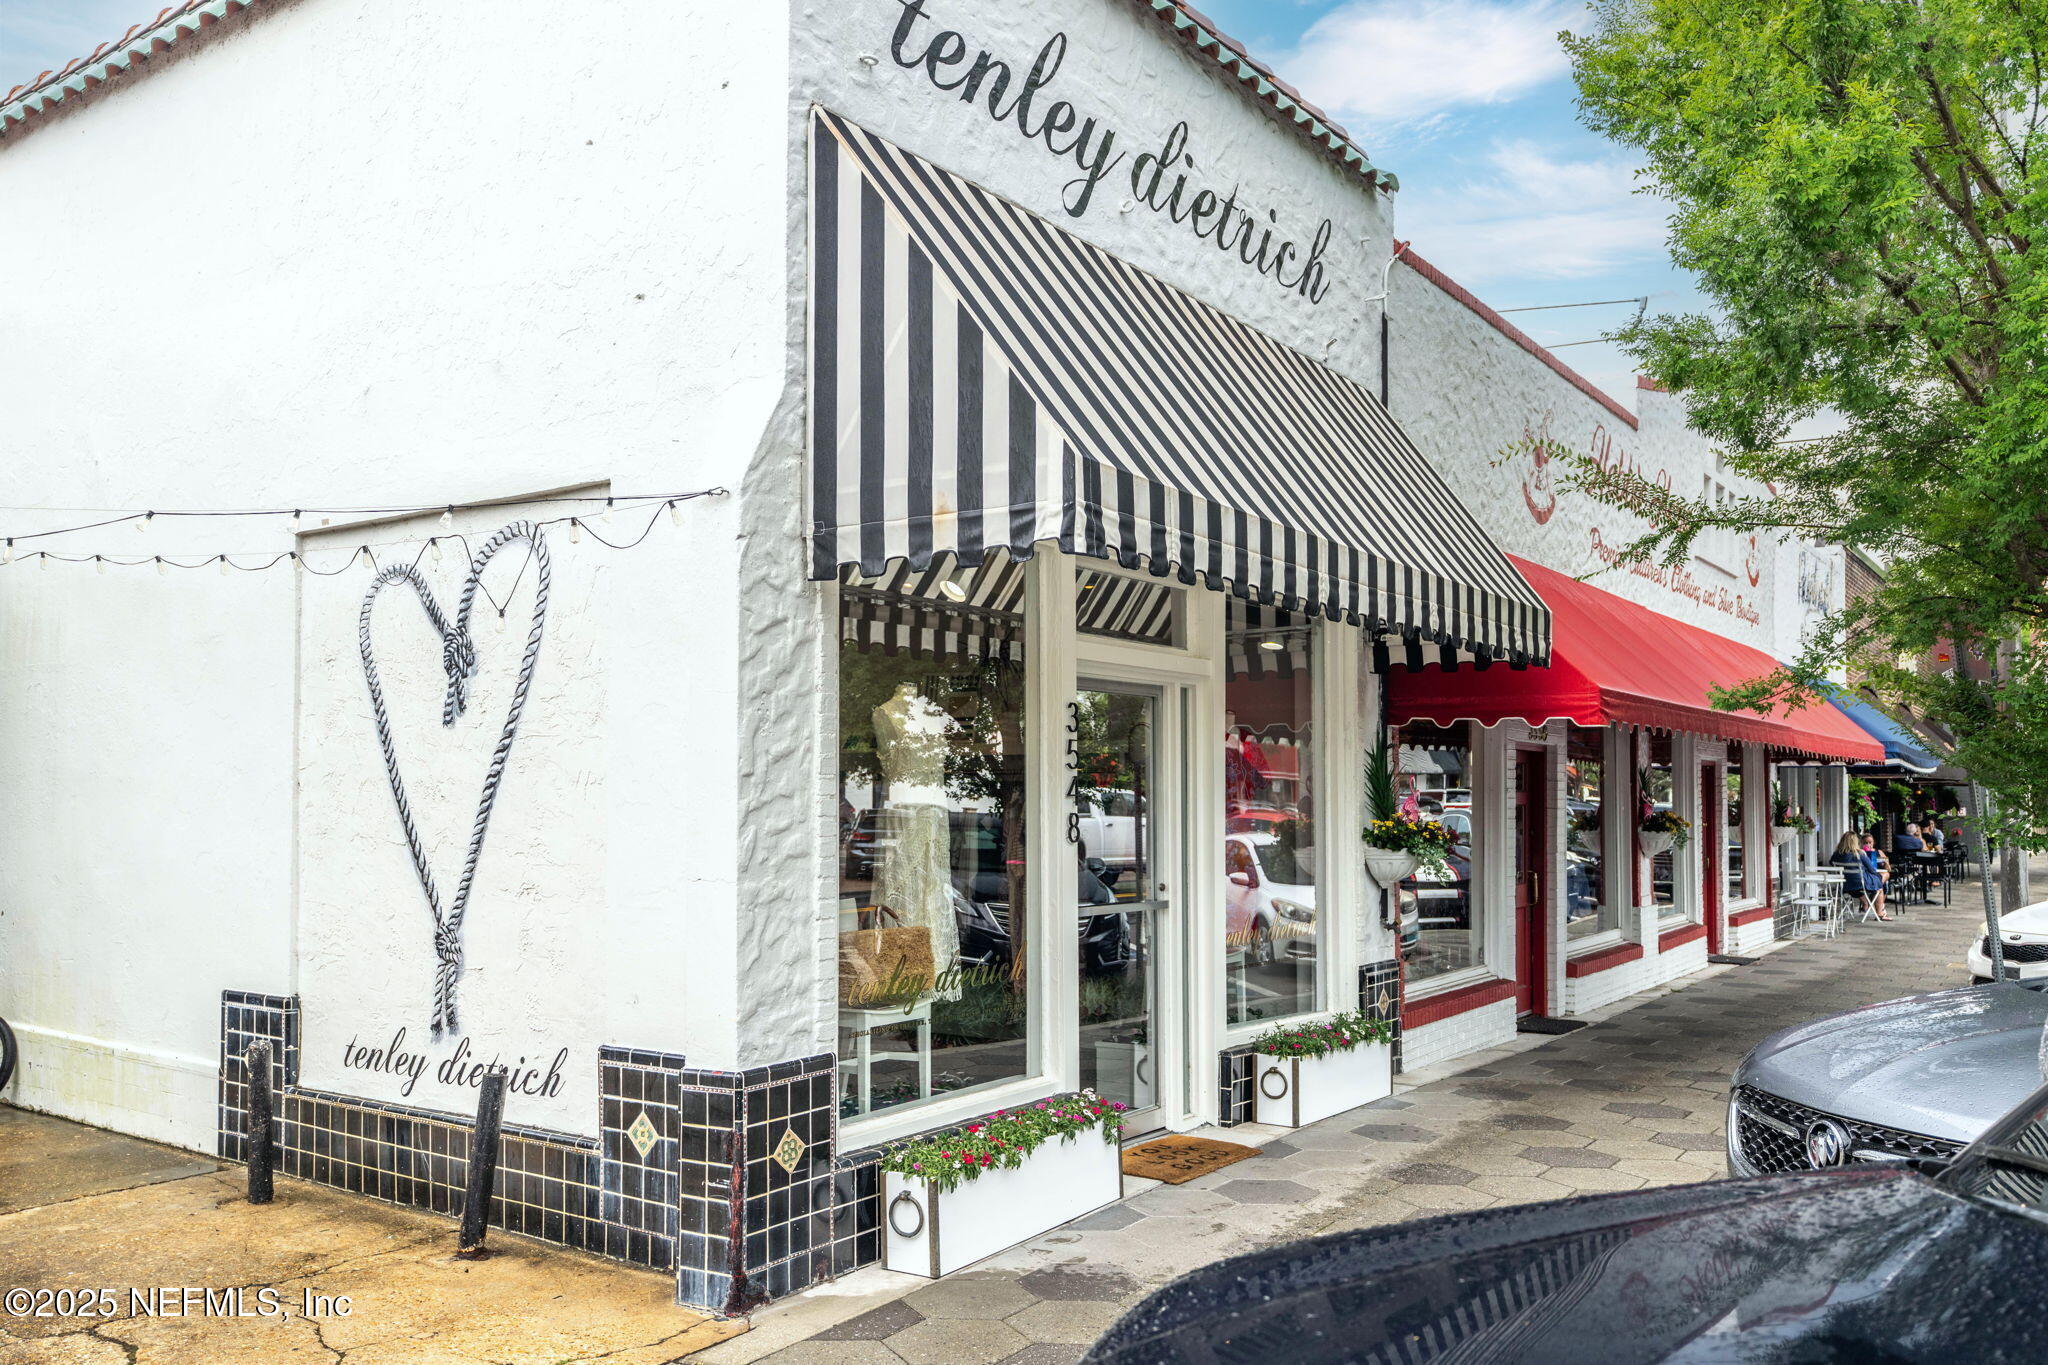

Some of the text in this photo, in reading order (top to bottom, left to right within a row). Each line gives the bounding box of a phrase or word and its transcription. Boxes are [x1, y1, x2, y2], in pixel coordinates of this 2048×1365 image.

[890, 0, 1331, 305] tenley dietrich
[1702, 584, 1716, 608] and
[1065, 702, 1080, 843] 3548
[1226, 912, 1262, 958] enley
[847, 940, 1027, 1016] tenley dietrich
[343, 1026, 431, 1098] tenley
[1128, 1144, 1173, 1158] YOU
[1146, 1145, 1202, 1165] LOOK
[1171, 1149, 1231, 1170] GOOD
